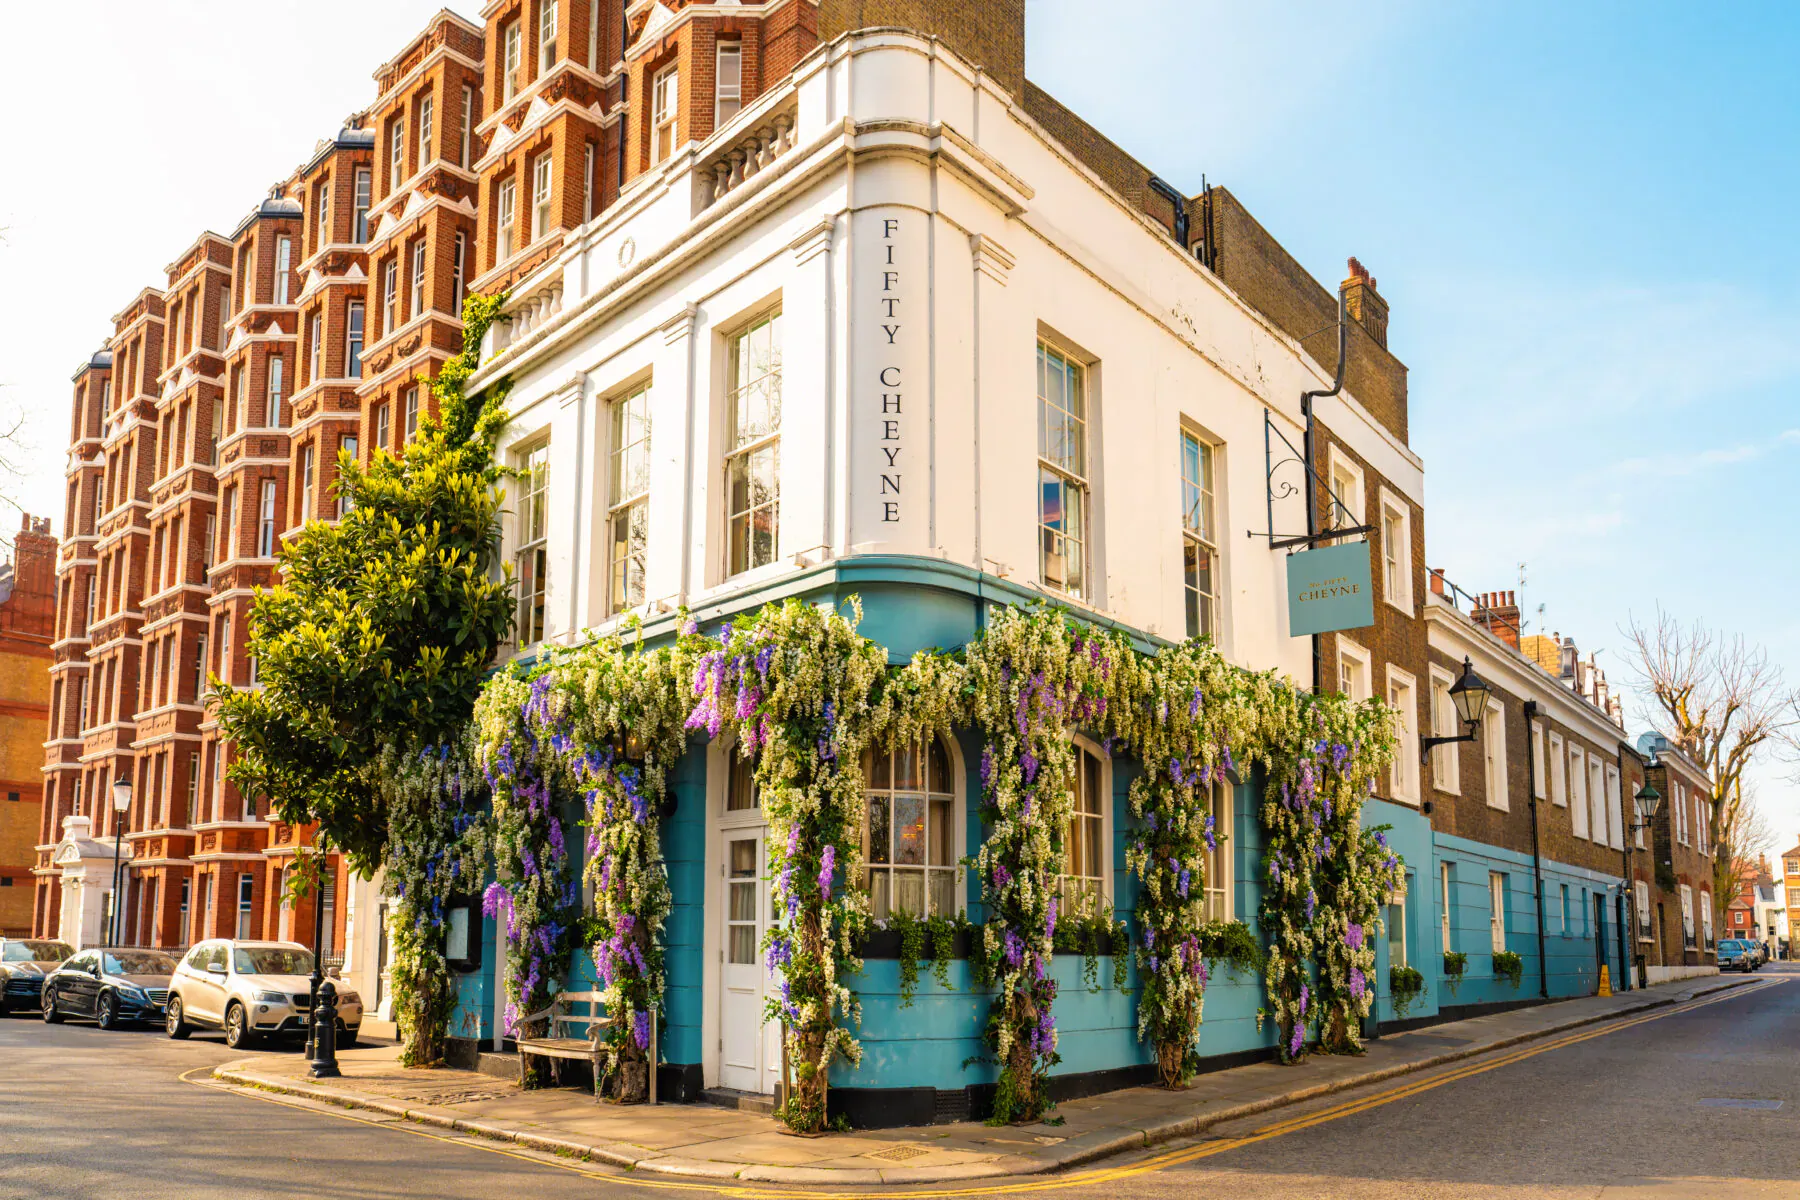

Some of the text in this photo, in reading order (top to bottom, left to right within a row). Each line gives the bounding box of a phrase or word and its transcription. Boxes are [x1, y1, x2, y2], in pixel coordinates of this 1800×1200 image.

[880, 219, 902, 522] FIFTY CHEYNE
[1299, 584, 1360, 602] CHEYNE
